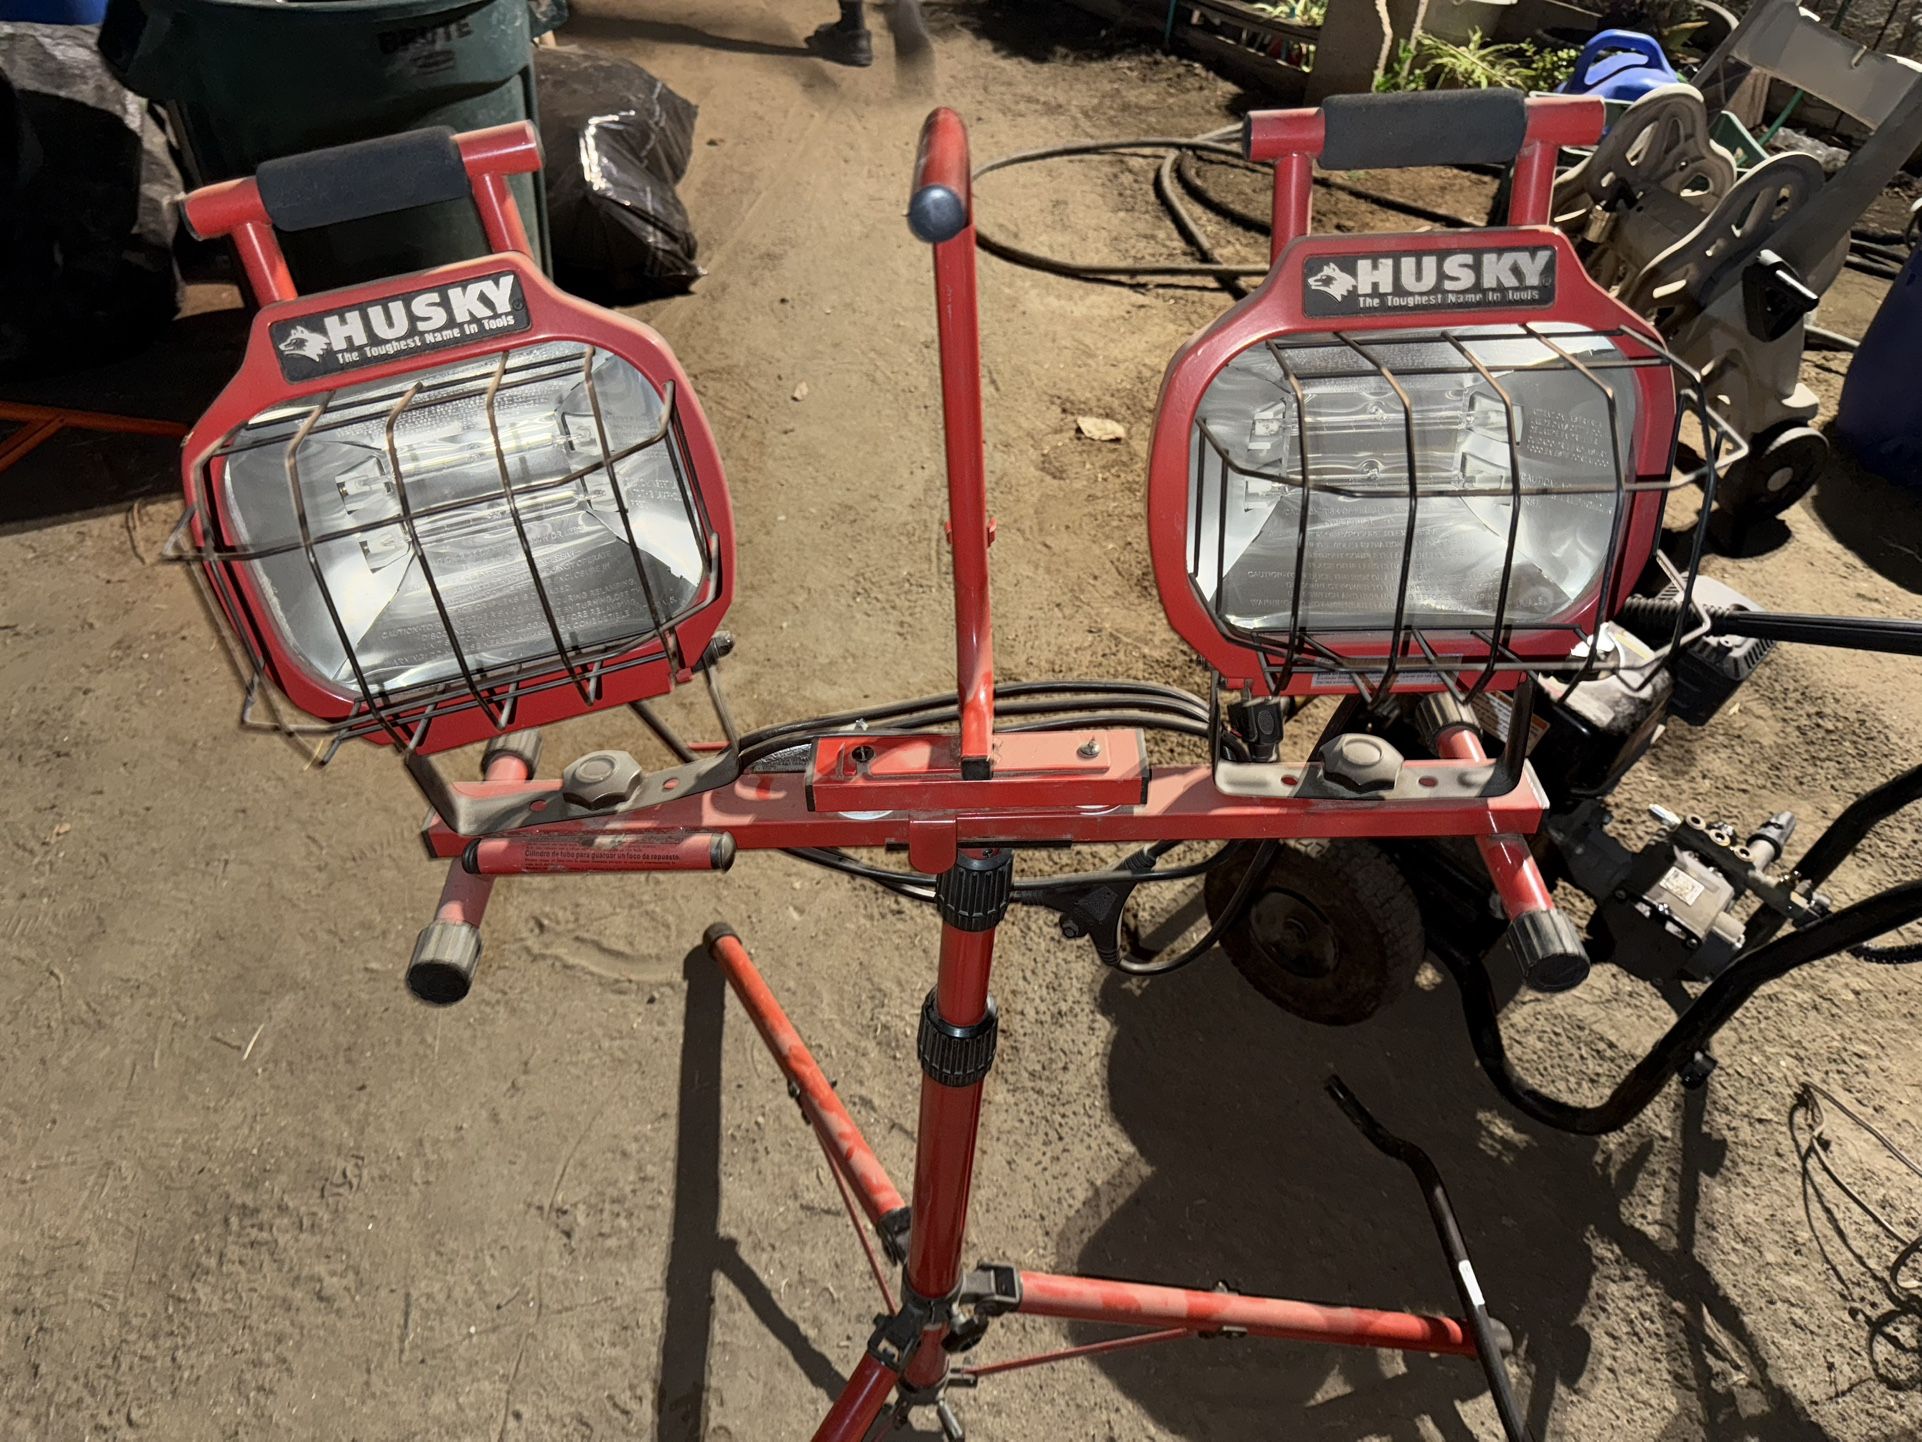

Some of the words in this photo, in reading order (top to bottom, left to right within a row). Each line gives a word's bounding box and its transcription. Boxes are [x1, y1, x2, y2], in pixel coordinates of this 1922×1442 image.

[1356, 250, 1553, 294] HUSKY
[323, 274, 515, 352] HUSKY
[1358, 296, 1380, 309] The
[1386, 292, 1442, 307] Toughest
[1447, 291, 1482, 304] Name
[1488, 291, 1500, 302] In
[336, 351, 360, 365] The
[364, 335, 421, 359] Toughest
[424, 327, 461, 347] Name
[464, 322, 479, 336] In
[481, 314, 515, 331] Tools
